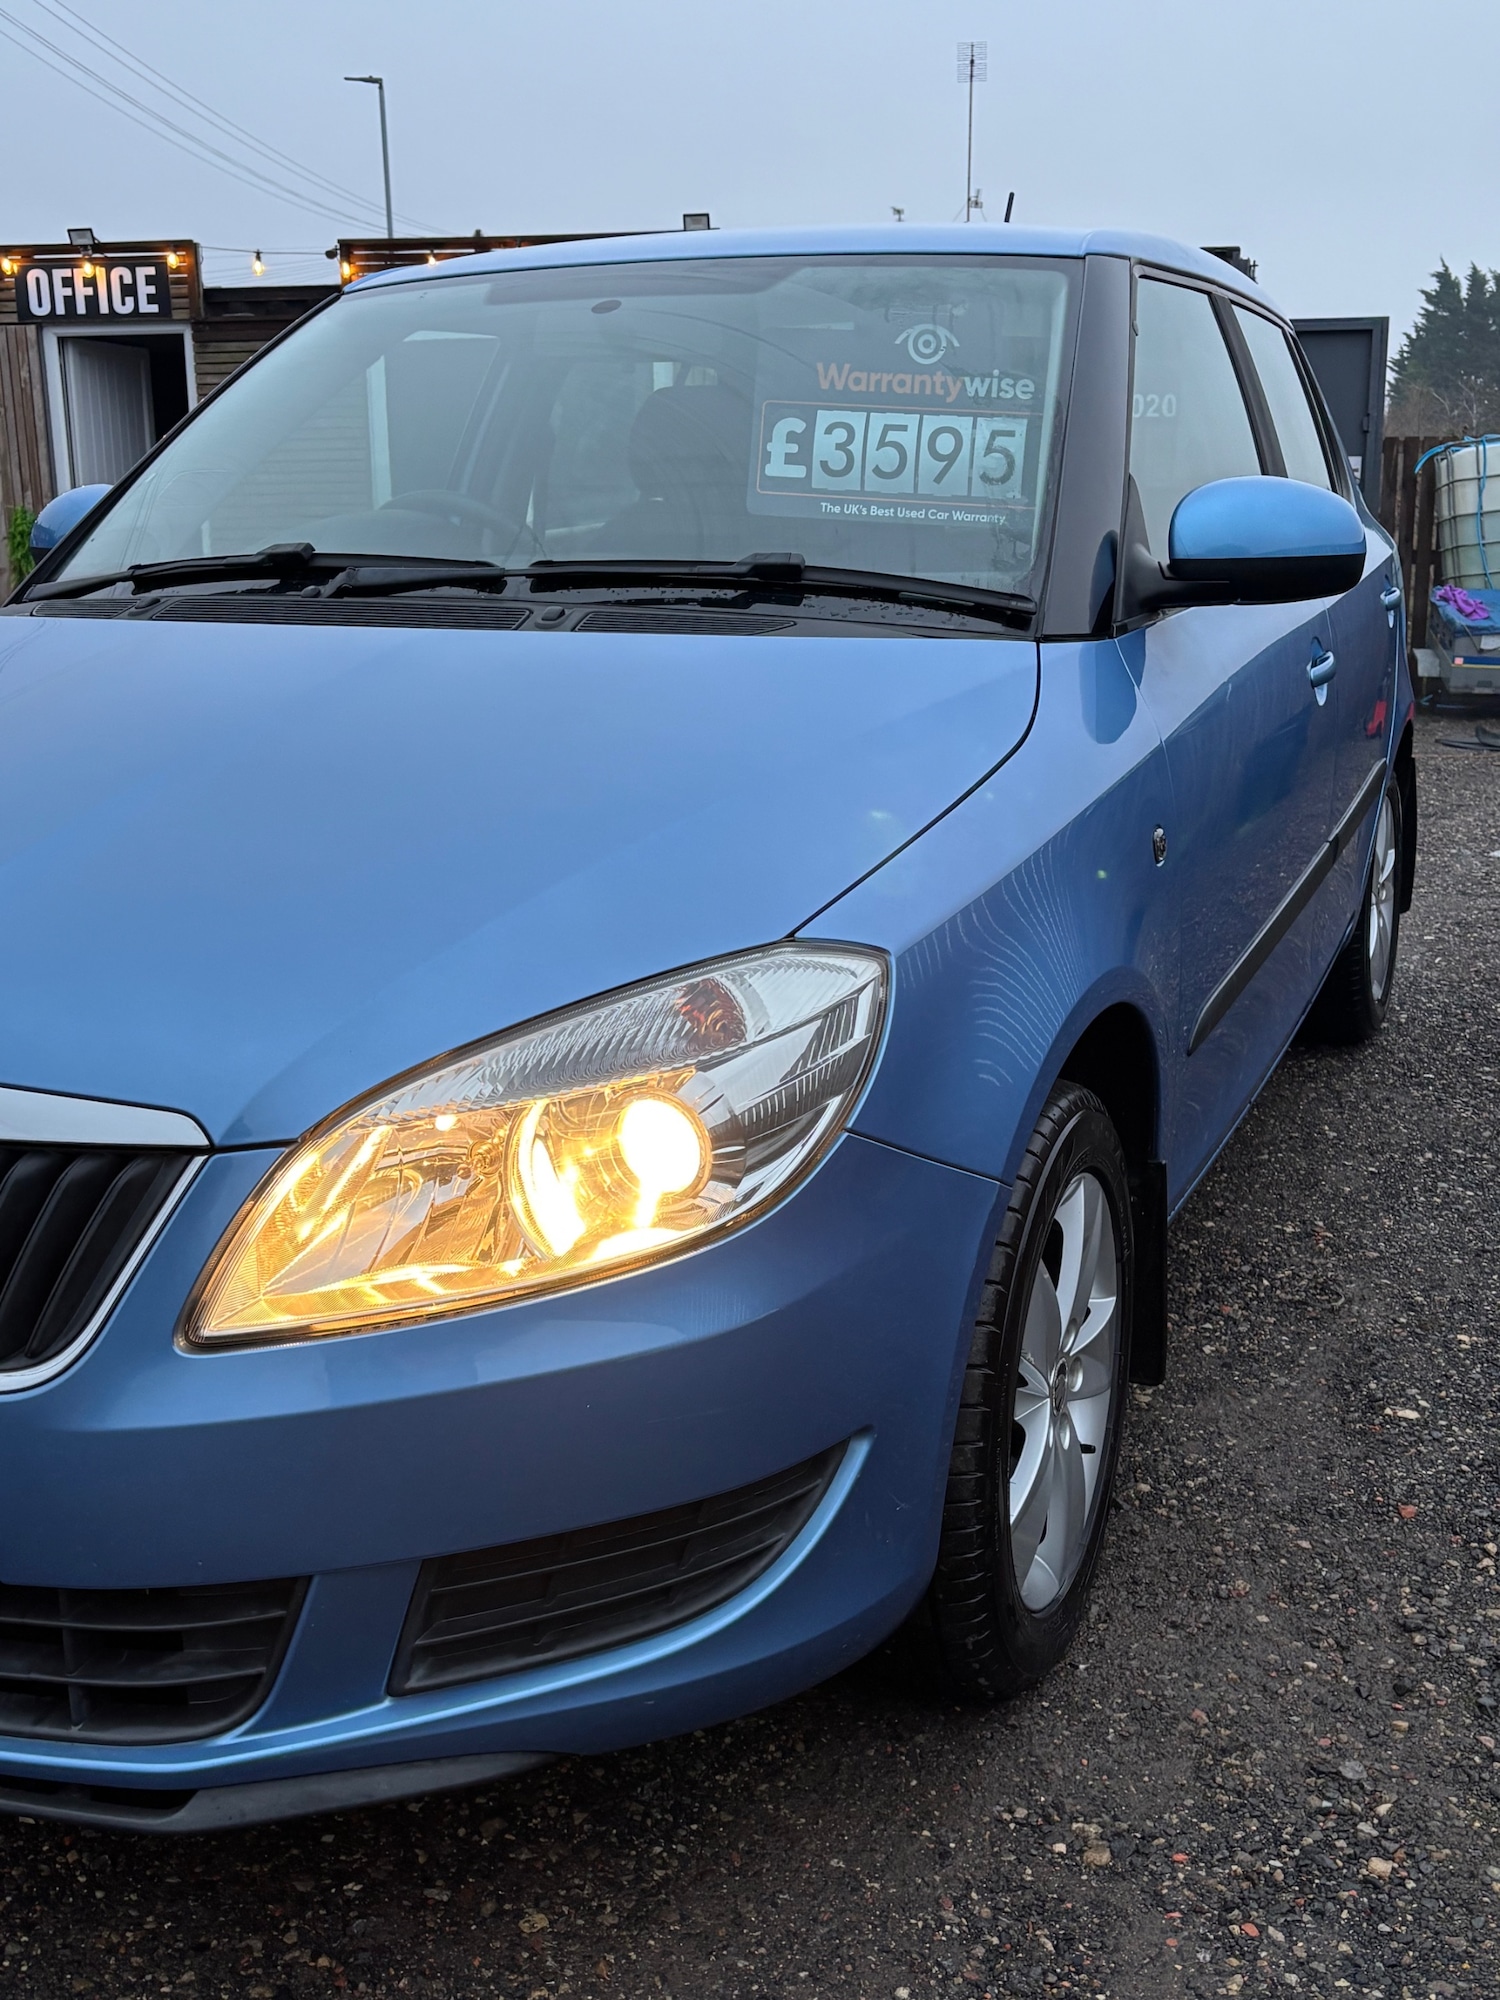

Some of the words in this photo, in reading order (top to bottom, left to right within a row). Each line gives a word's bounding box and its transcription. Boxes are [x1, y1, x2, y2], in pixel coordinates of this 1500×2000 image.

[26, 266, 160, 316] OFFICE
[816, 362, 1036, 403] Warrantywise
[765, 416, 1018, 487] £3595
[820, 502, 842, 514] The
[843, 504, 868, 516] UK's
[869, 505, 895, 517] Best
[897, 507, 925, 519] Used
[928, 508, 950, 520] Car
[951, 510, 1006, 525] Warranty
